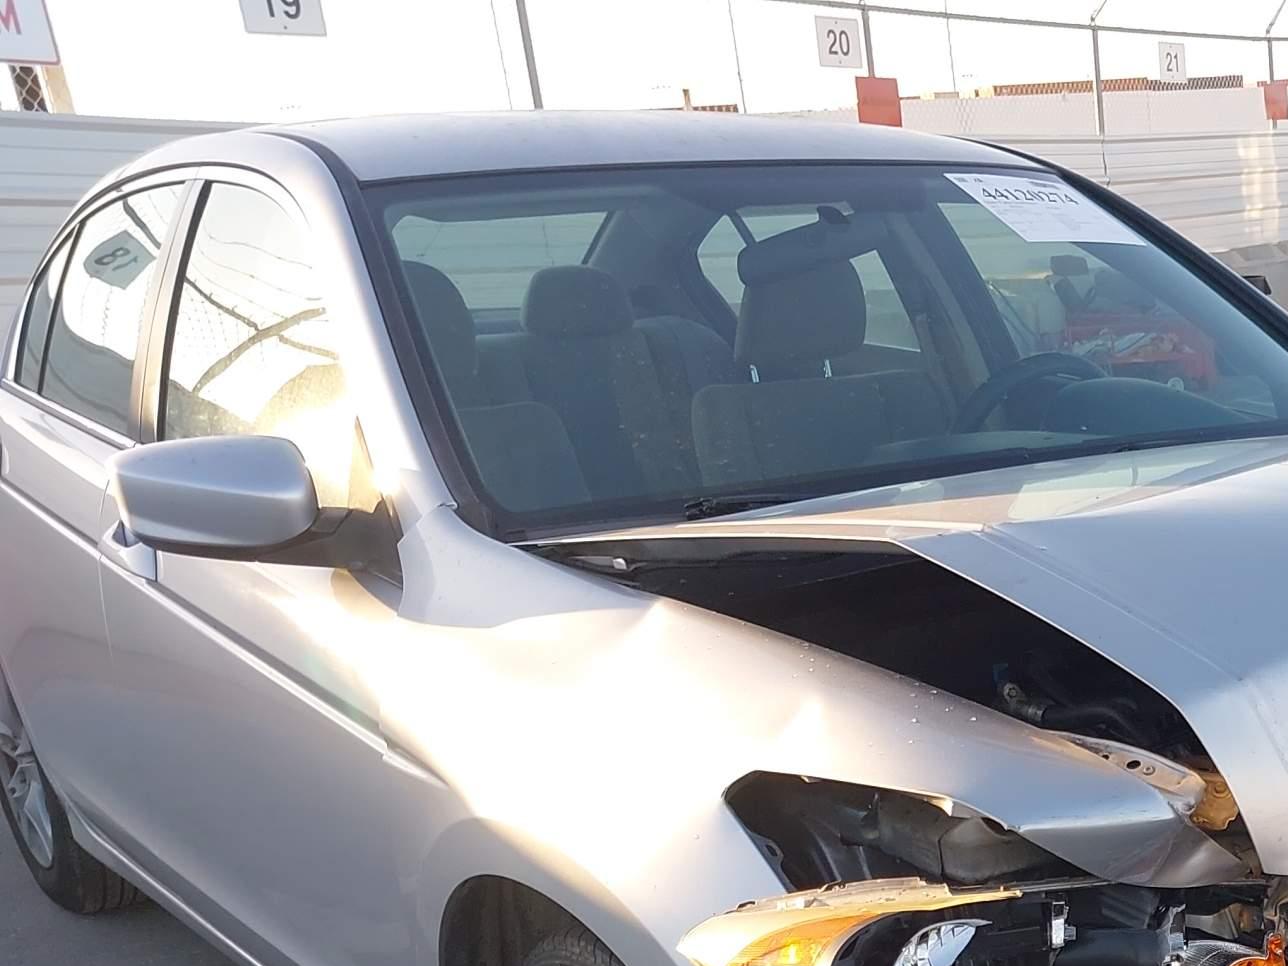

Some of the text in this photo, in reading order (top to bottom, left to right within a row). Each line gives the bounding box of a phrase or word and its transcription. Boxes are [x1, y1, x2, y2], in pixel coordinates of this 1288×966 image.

[826, 29, 850, 56] 20
[1166, 52, 1179, 72] 21
[981, 187, 1080, 206] 44120274
